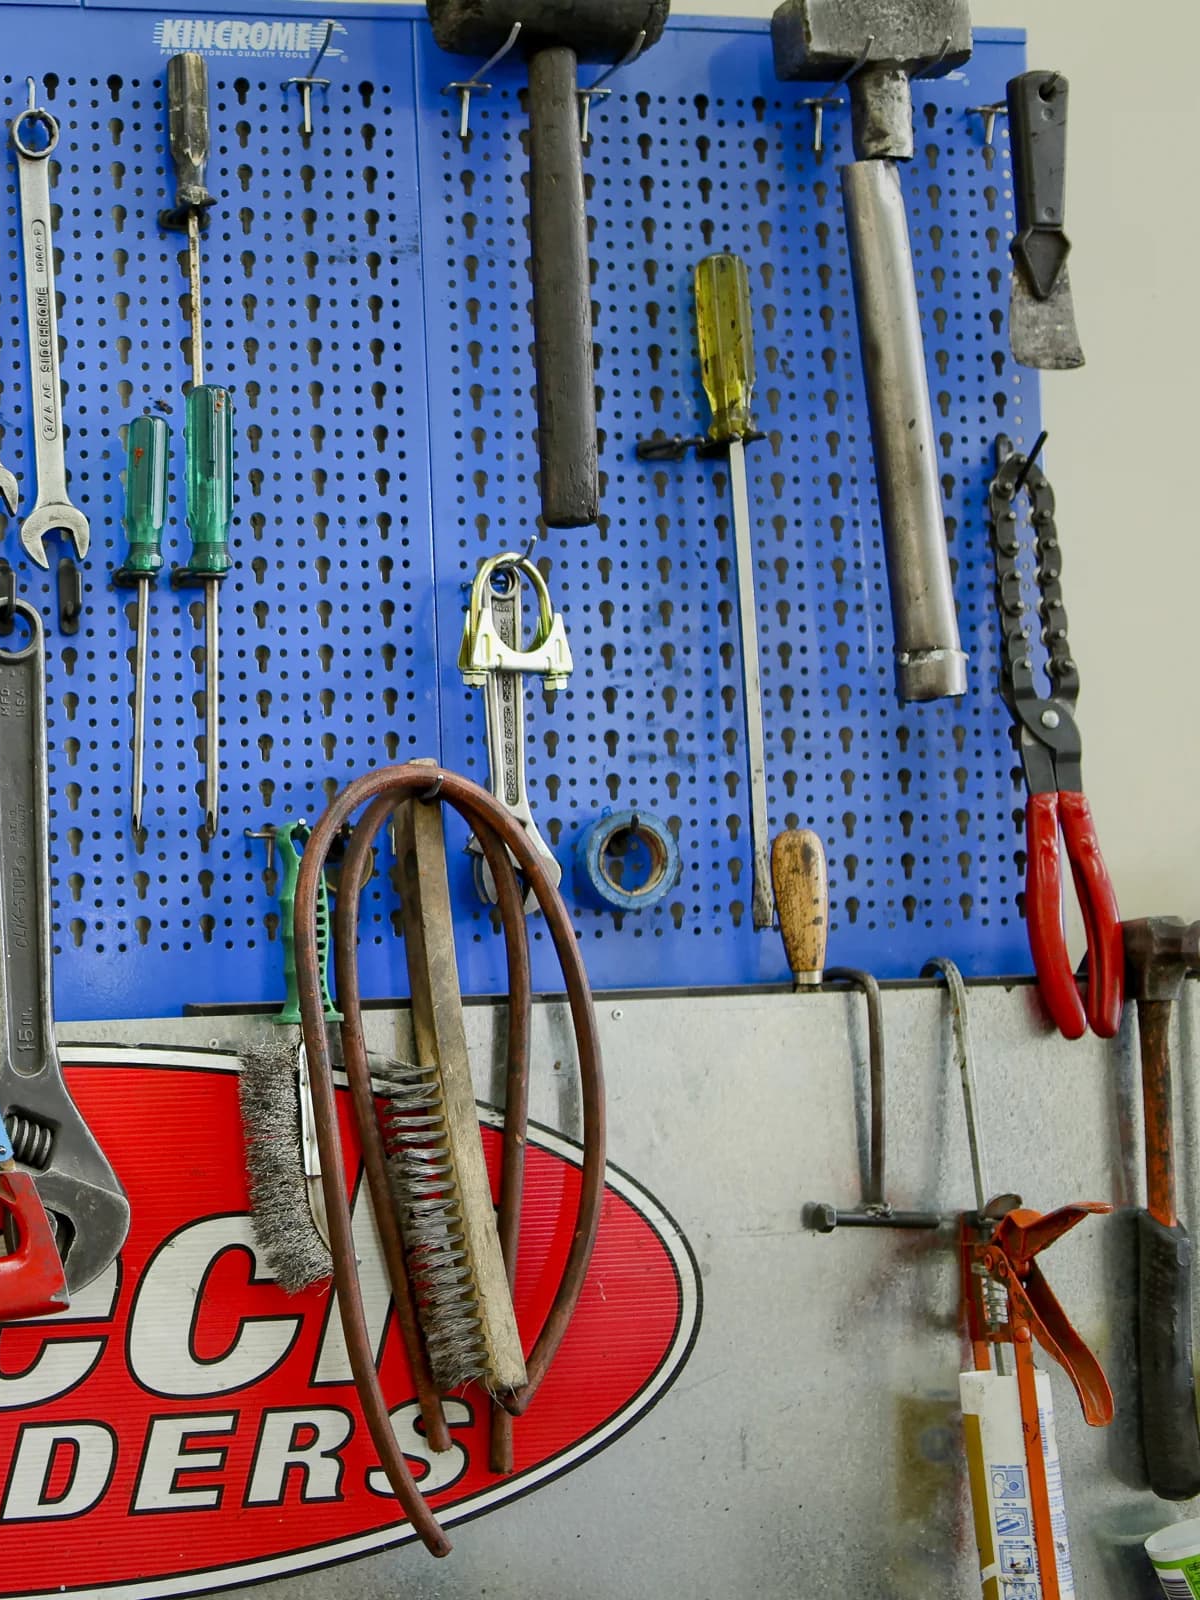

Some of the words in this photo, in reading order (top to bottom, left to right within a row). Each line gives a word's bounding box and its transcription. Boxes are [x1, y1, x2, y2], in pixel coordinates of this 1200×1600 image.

[160, 19, 313, 51] KINCROME
[237, 49, 276, 58] QUALITY
[279, 50, 311, 59] TOOLS
[36, 286, 51, 373] SIDCHROME
